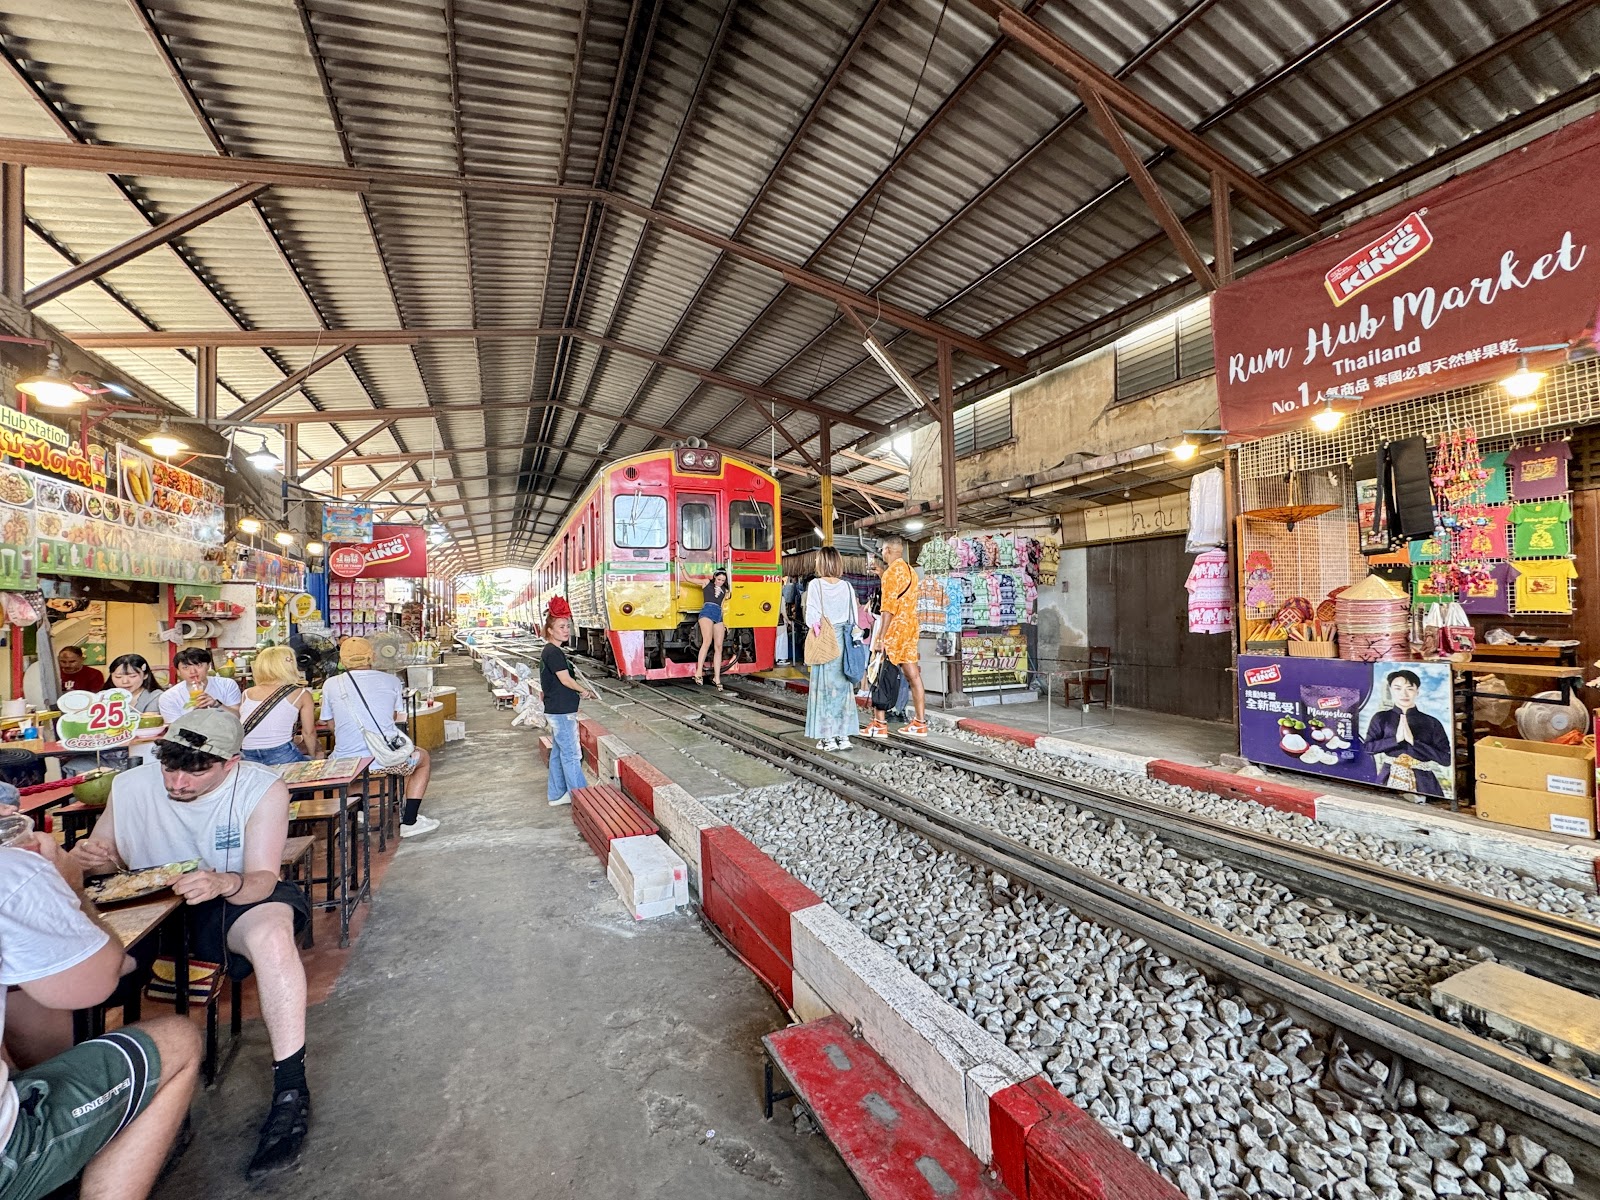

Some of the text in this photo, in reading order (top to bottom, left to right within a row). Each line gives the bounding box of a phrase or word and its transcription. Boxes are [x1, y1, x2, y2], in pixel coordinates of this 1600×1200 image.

[1369, 223, 1414, 259] Fruit
[1340, 232, 1421, 295] KING
[1228, 231, 1586, 385] Rum Hub Market
[1332, 336, 1422, 376] Thailand
[1, 407, 27, 430] Hub
[28, 418, 68, 446] Station
[762, 574, 780, 583] 1216
[1249, 671, 1278, 684] KING
[1306, 706, 1353, 719] Mangosteen
[66, 730, 131, 748] Coconut
